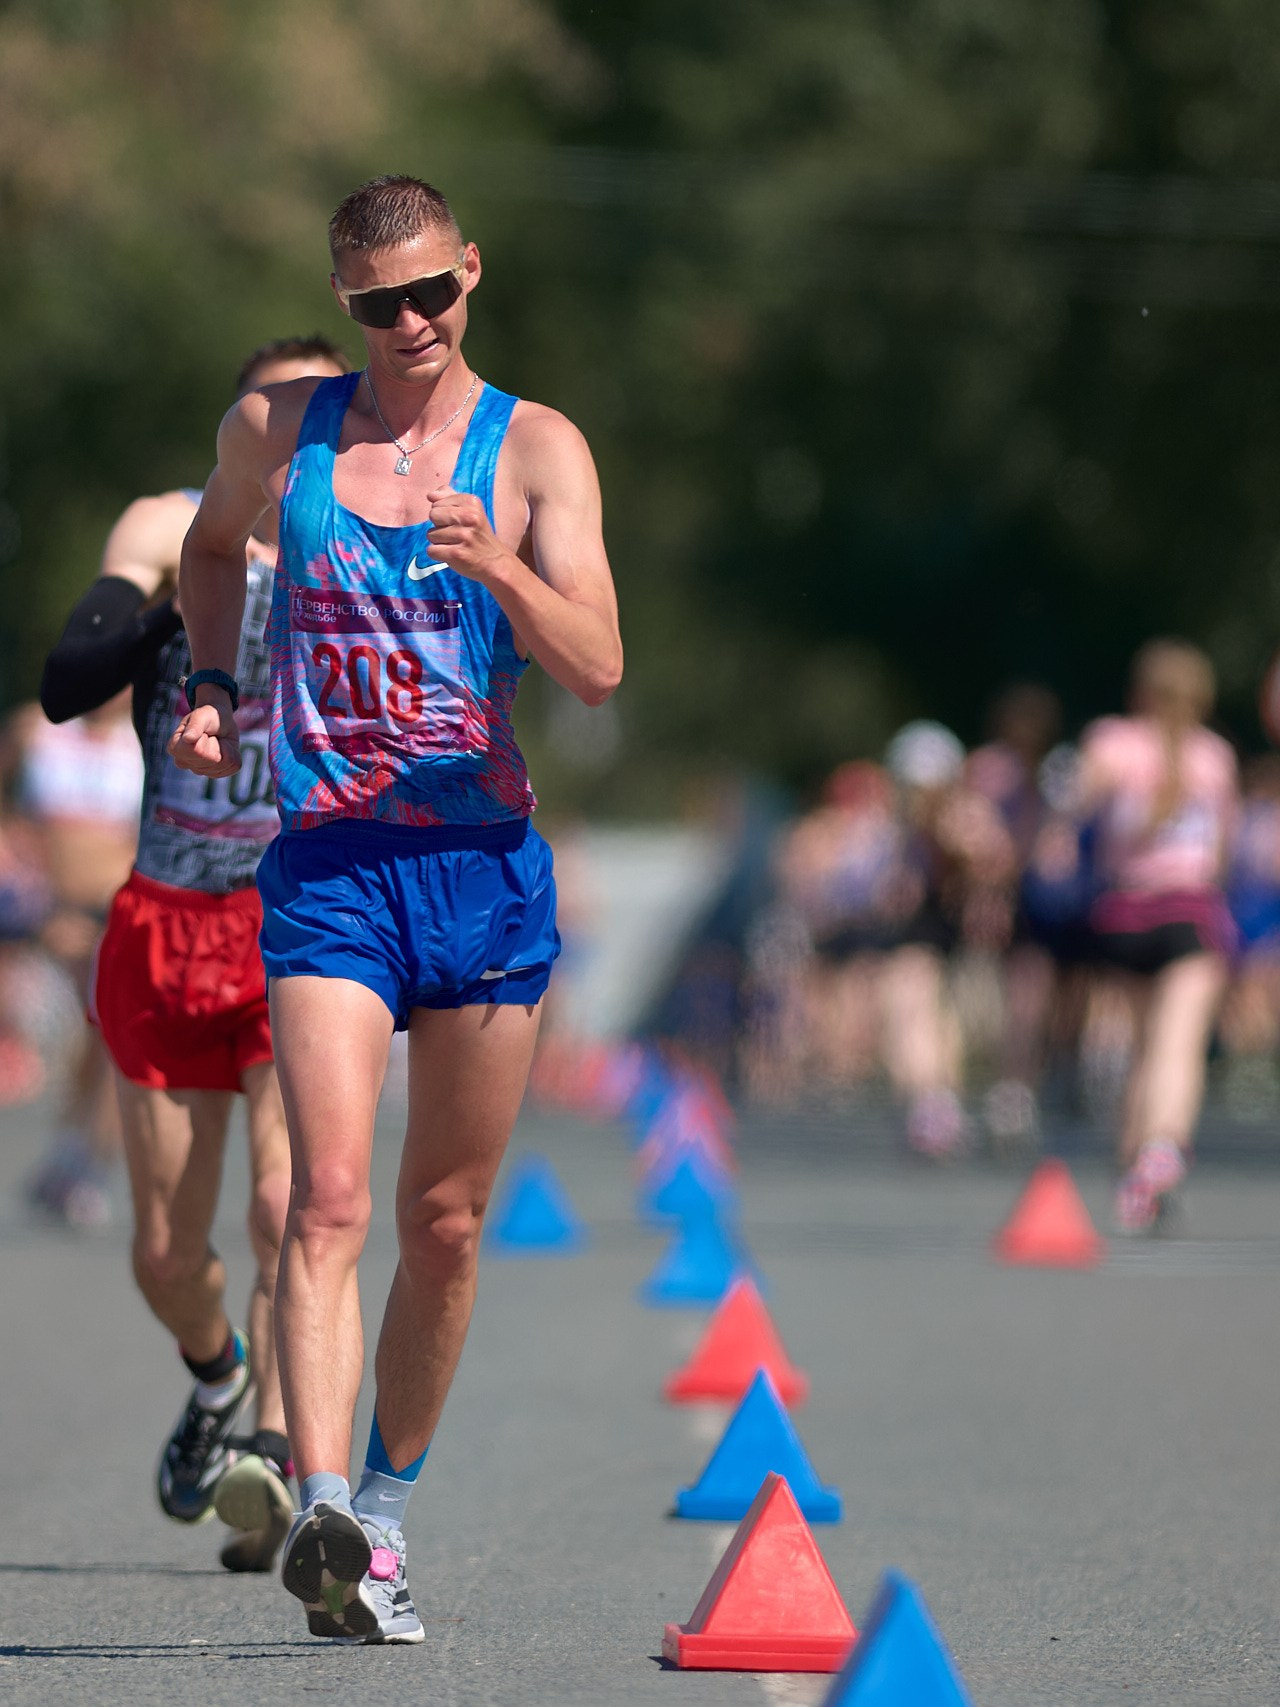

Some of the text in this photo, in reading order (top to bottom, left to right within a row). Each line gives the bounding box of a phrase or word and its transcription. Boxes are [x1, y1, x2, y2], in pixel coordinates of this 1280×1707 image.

[291, 597, 446, 623] ПЕРВЕНСТВО РОССИИ
[312, 642, 424, 724] 208
